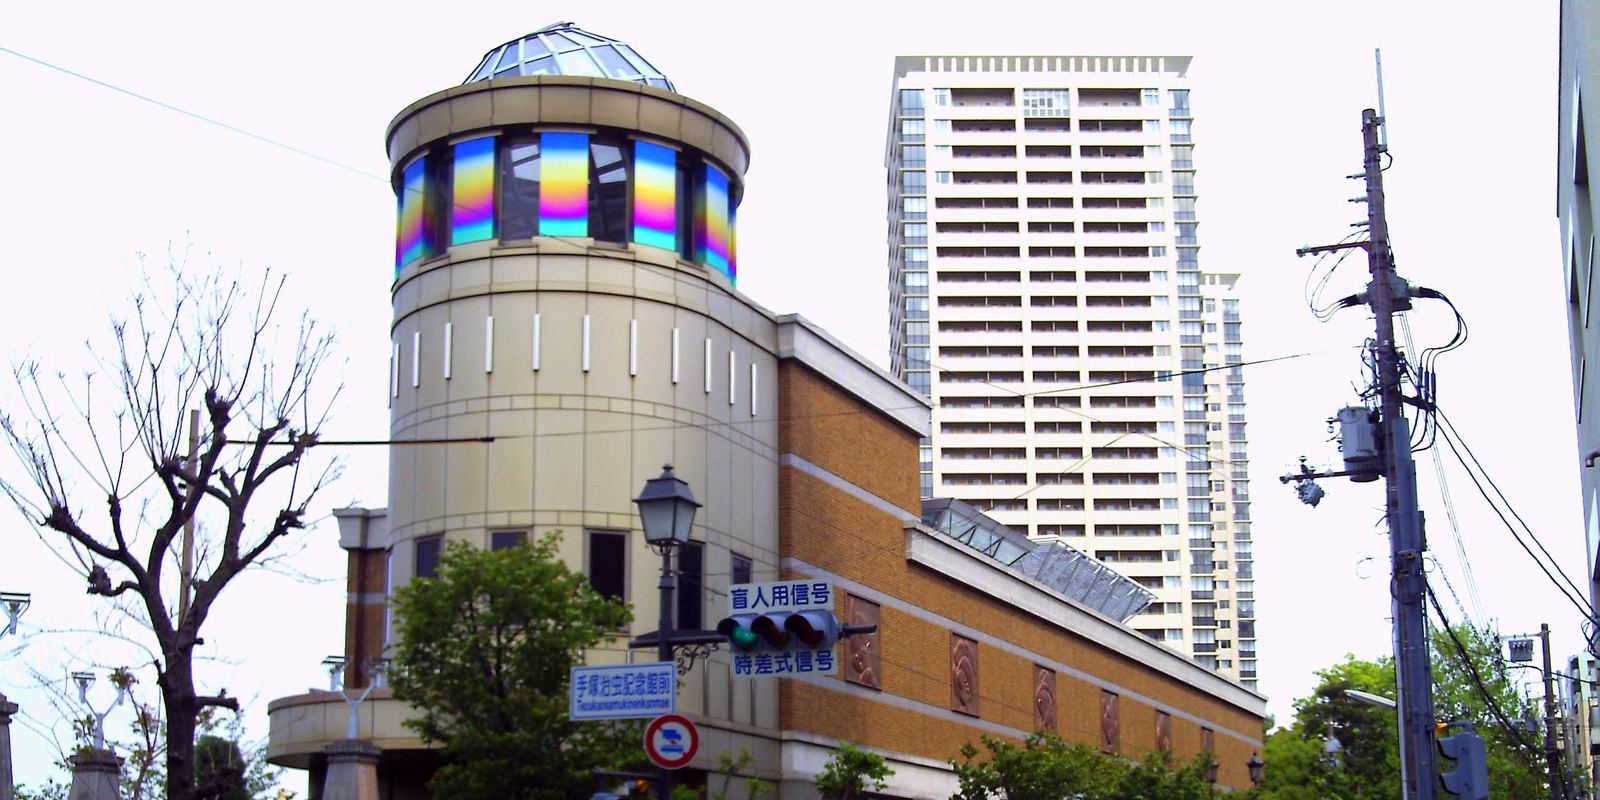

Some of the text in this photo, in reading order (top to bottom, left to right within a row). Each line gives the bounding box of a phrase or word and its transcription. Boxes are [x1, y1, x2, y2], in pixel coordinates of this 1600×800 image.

[731, 583, 830, 609] 盲人用信号
[734, 650, 833, 675] 時差式信号
[577, 672, 670, 698] 手塚治虫記念館前
